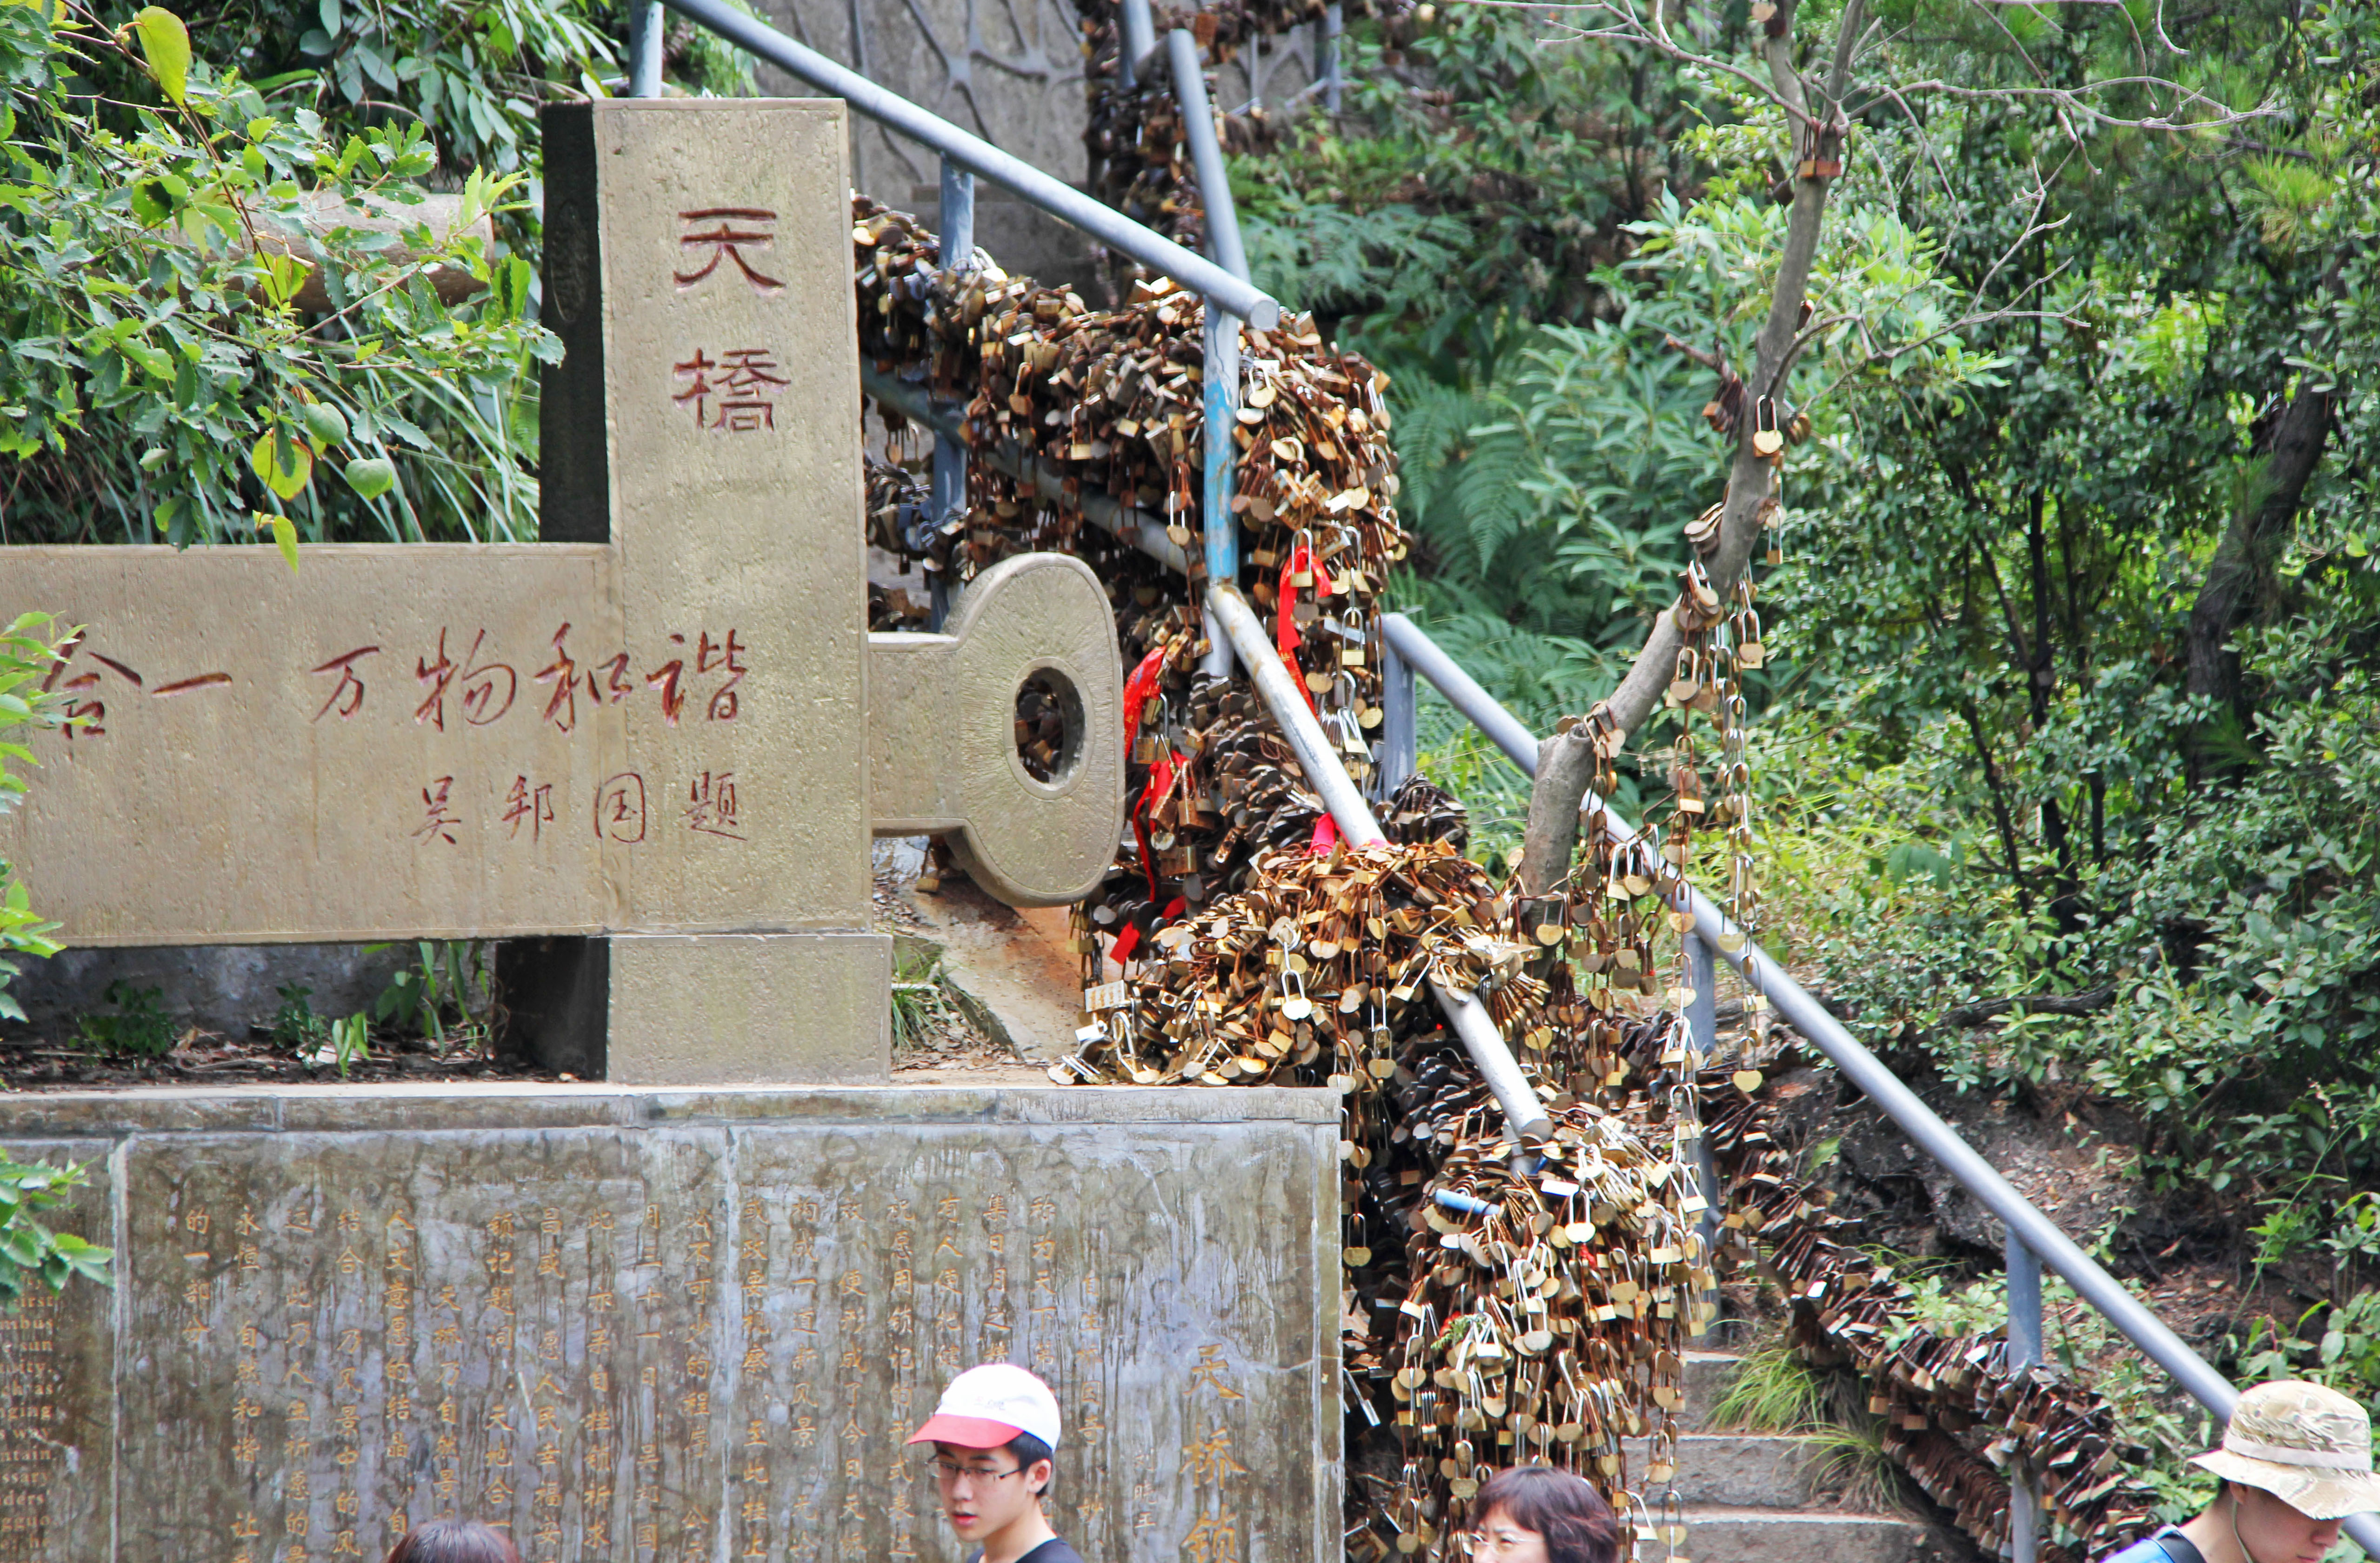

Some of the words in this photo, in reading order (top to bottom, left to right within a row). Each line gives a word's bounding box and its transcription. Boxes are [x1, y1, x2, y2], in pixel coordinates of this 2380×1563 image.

[673, 207, 792, 433] 天橋
[411, 771, 748, 846] 吴邦国题
[13, 1293, 54, 1308] irst
